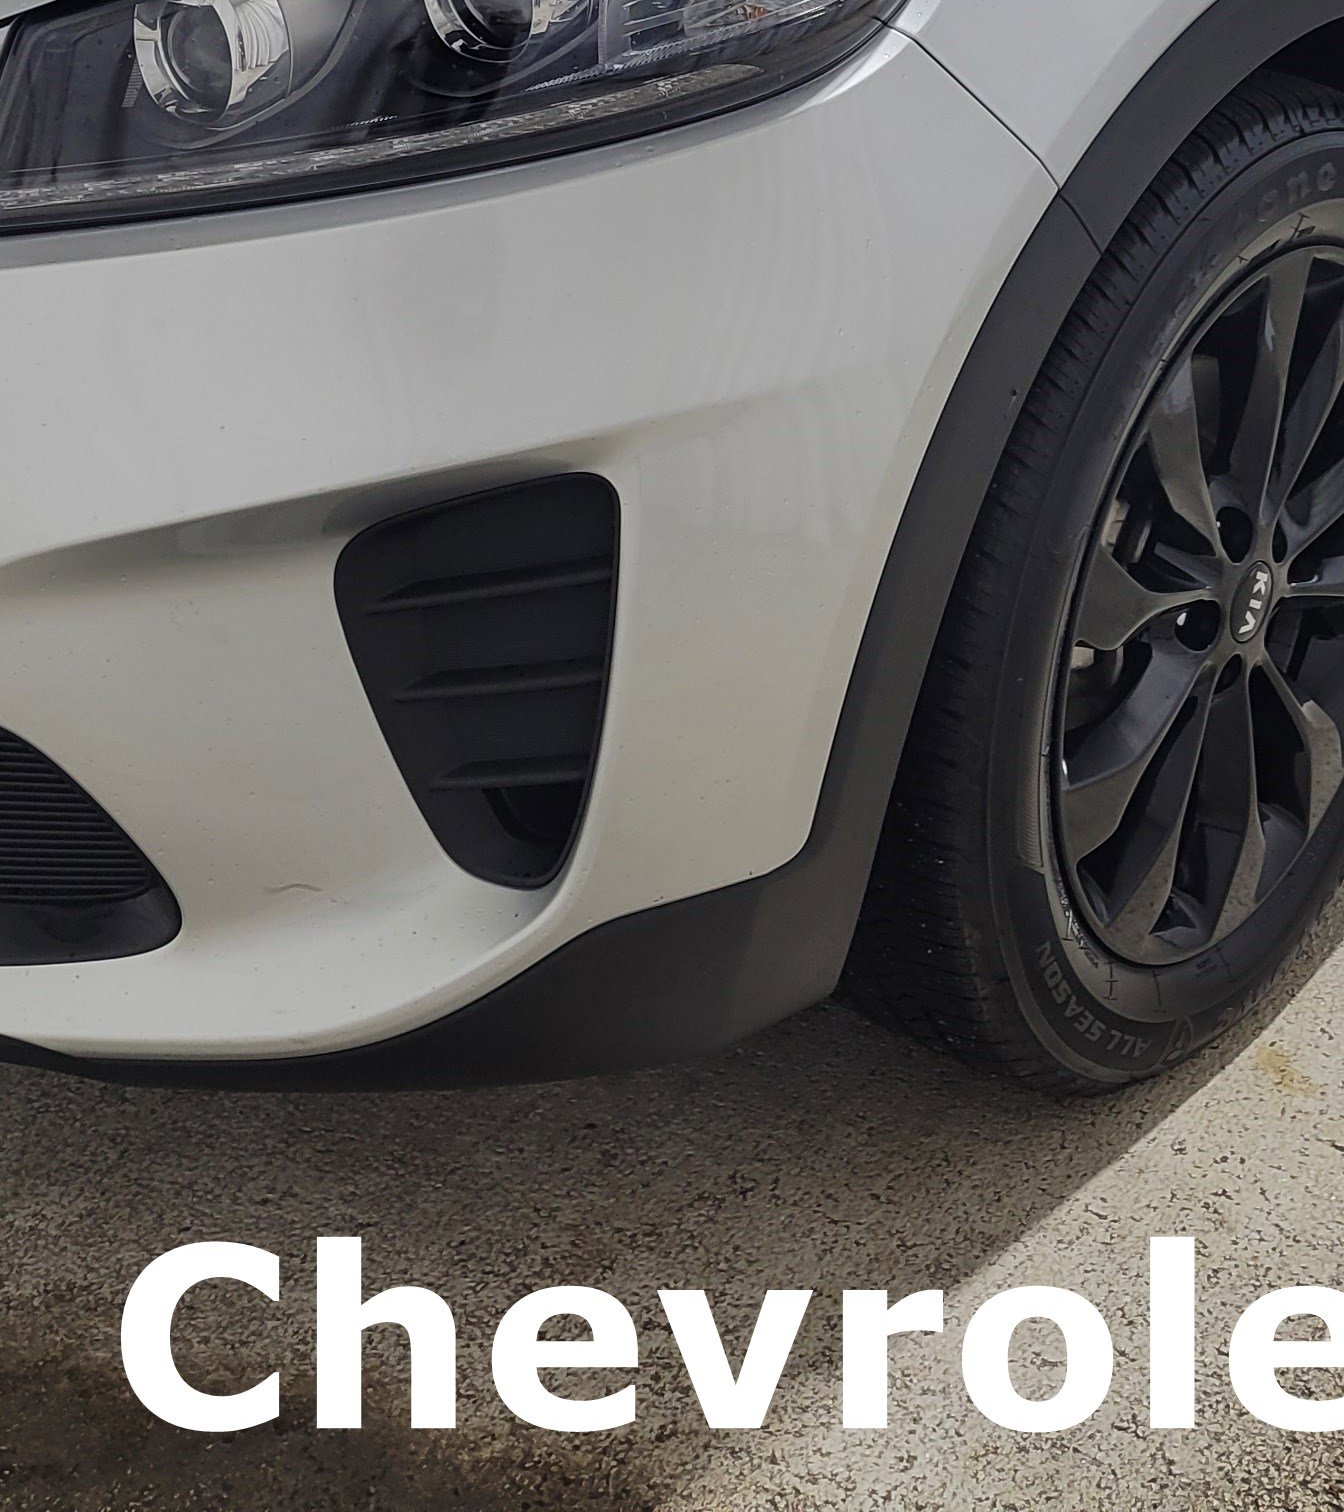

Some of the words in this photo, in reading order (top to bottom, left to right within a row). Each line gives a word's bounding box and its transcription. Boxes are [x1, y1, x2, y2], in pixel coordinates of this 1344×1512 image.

[1238, 570, 1268, 634] KIA
[1036, 940, 1105, 1042] SEASON
[1107, 1029, 1153, 1057] ALL
